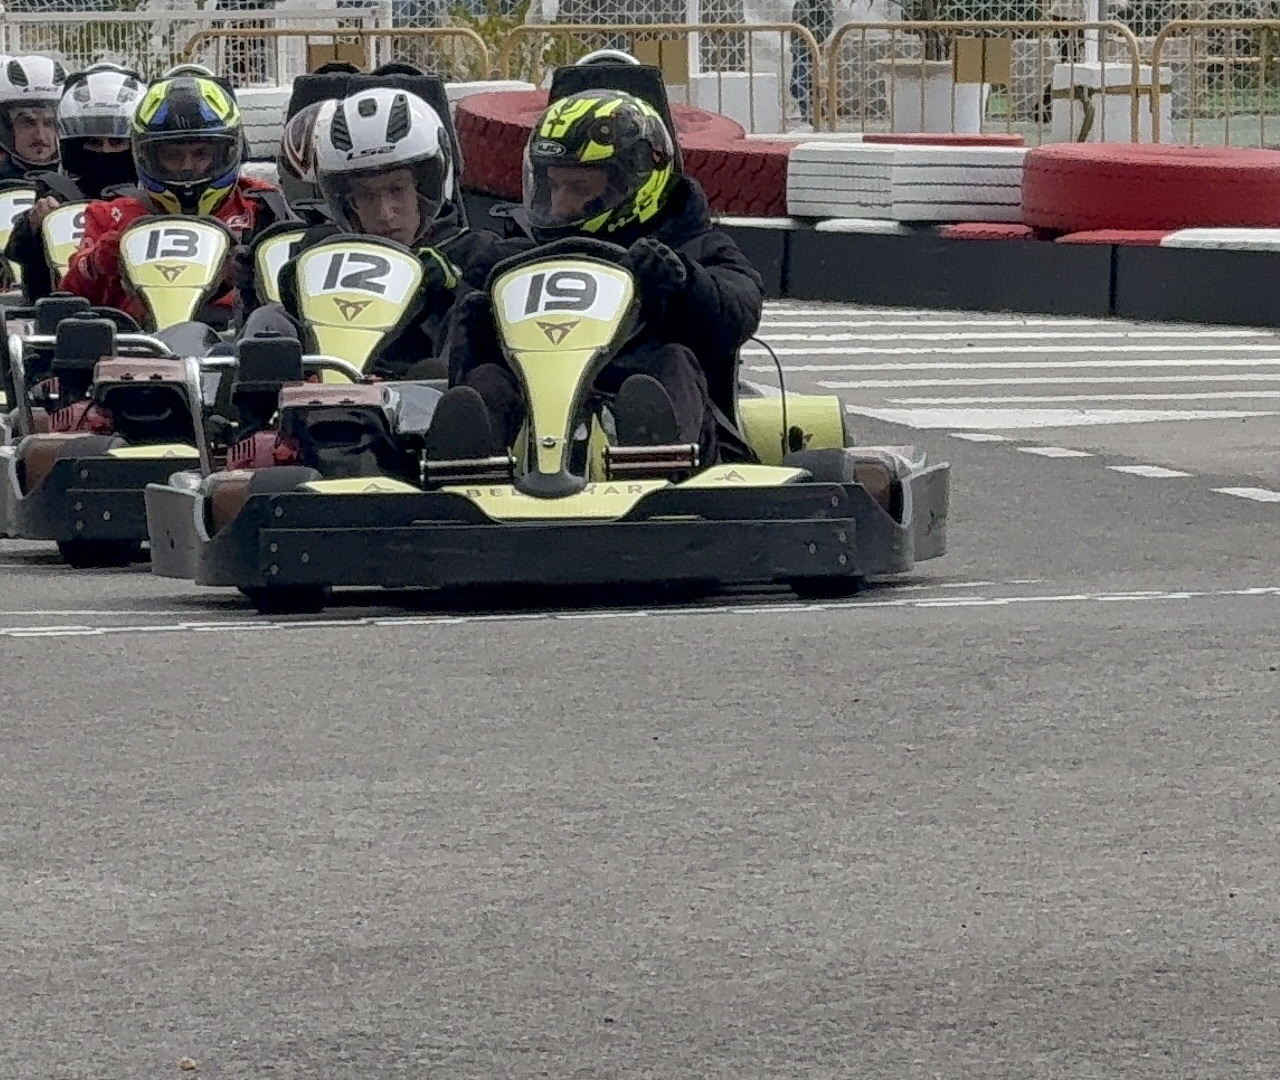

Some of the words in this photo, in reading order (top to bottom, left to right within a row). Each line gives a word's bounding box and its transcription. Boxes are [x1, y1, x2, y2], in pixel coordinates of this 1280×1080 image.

[146, 229, 199, 261] 13
[323, 253, 392, 295] 12
[524, 271, 598, 316] 19
